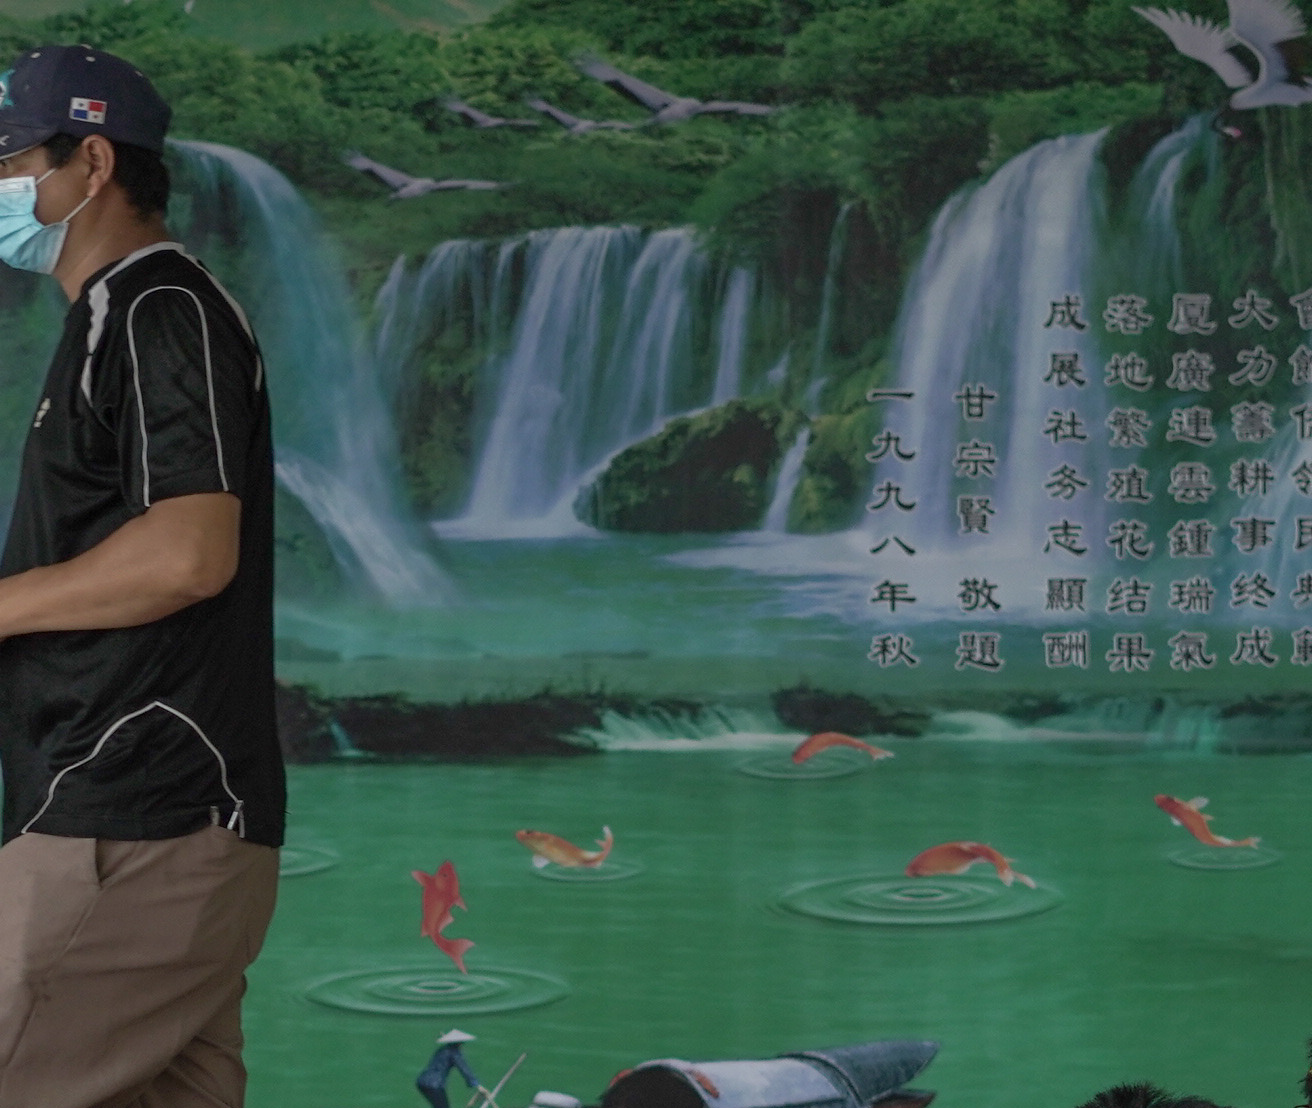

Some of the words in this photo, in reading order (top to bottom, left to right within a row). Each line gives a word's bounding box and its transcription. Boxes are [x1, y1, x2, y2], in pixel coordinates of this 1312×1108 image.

[869, 389, 918, 667] 一九九八年秋
[1106, 296, 1154, 670] 落地繁殖花结果
